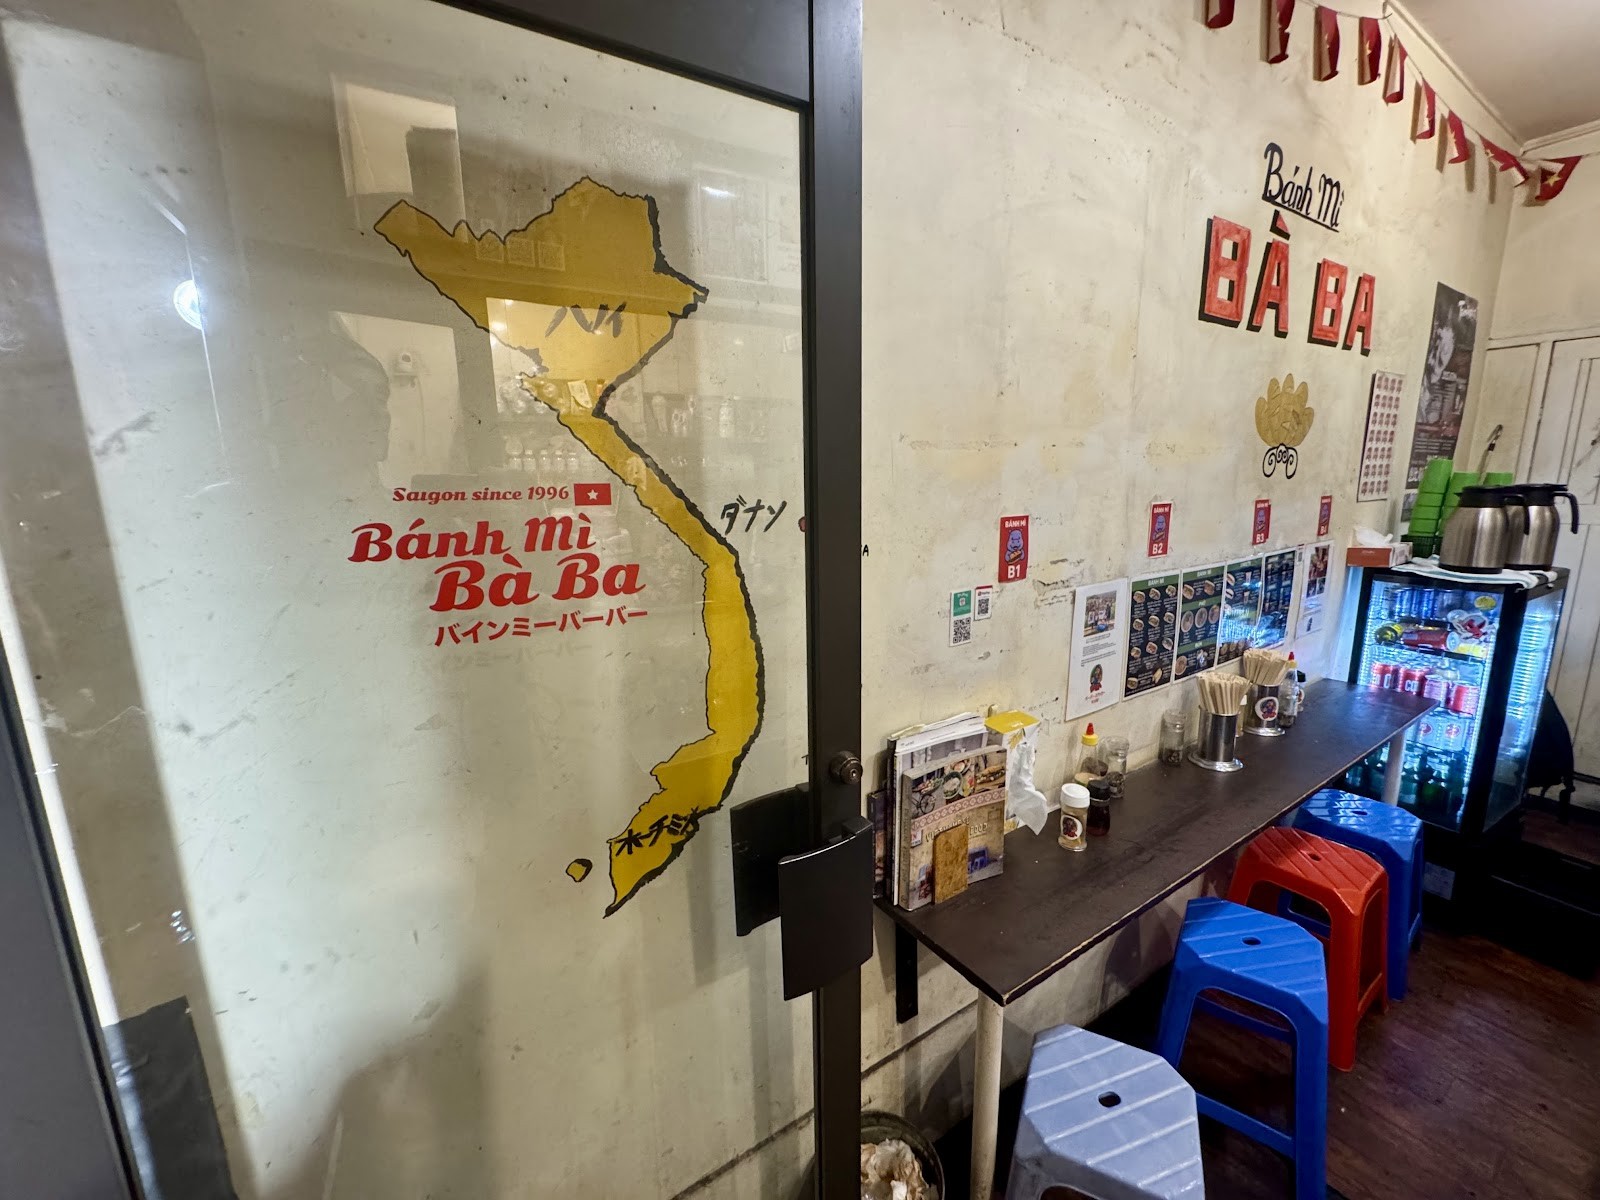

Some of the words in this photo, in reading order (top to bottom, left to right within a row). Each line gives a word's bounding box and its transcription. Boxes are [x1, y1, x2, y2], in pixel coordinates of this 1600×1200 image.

[1263, 142, 1313, 216] Bánh
[1198, 209, 1291, 339] BÀ
[1307, 258, 1376, 357] BA
[393, 487, 468, 502] Saigon
[471, 485, 522, 501] since
[528, 485, 569, 501] 1996
[348, 518, 511, 562] Bánh
[1152, 542, 1163, 554] B2
[429, 552, 539, 612] Bà
[552, 554, 646, 601] Ba
[1008, 564, 1021, 579] B1
[434, 604, 648, 647] バインミーバーバー
